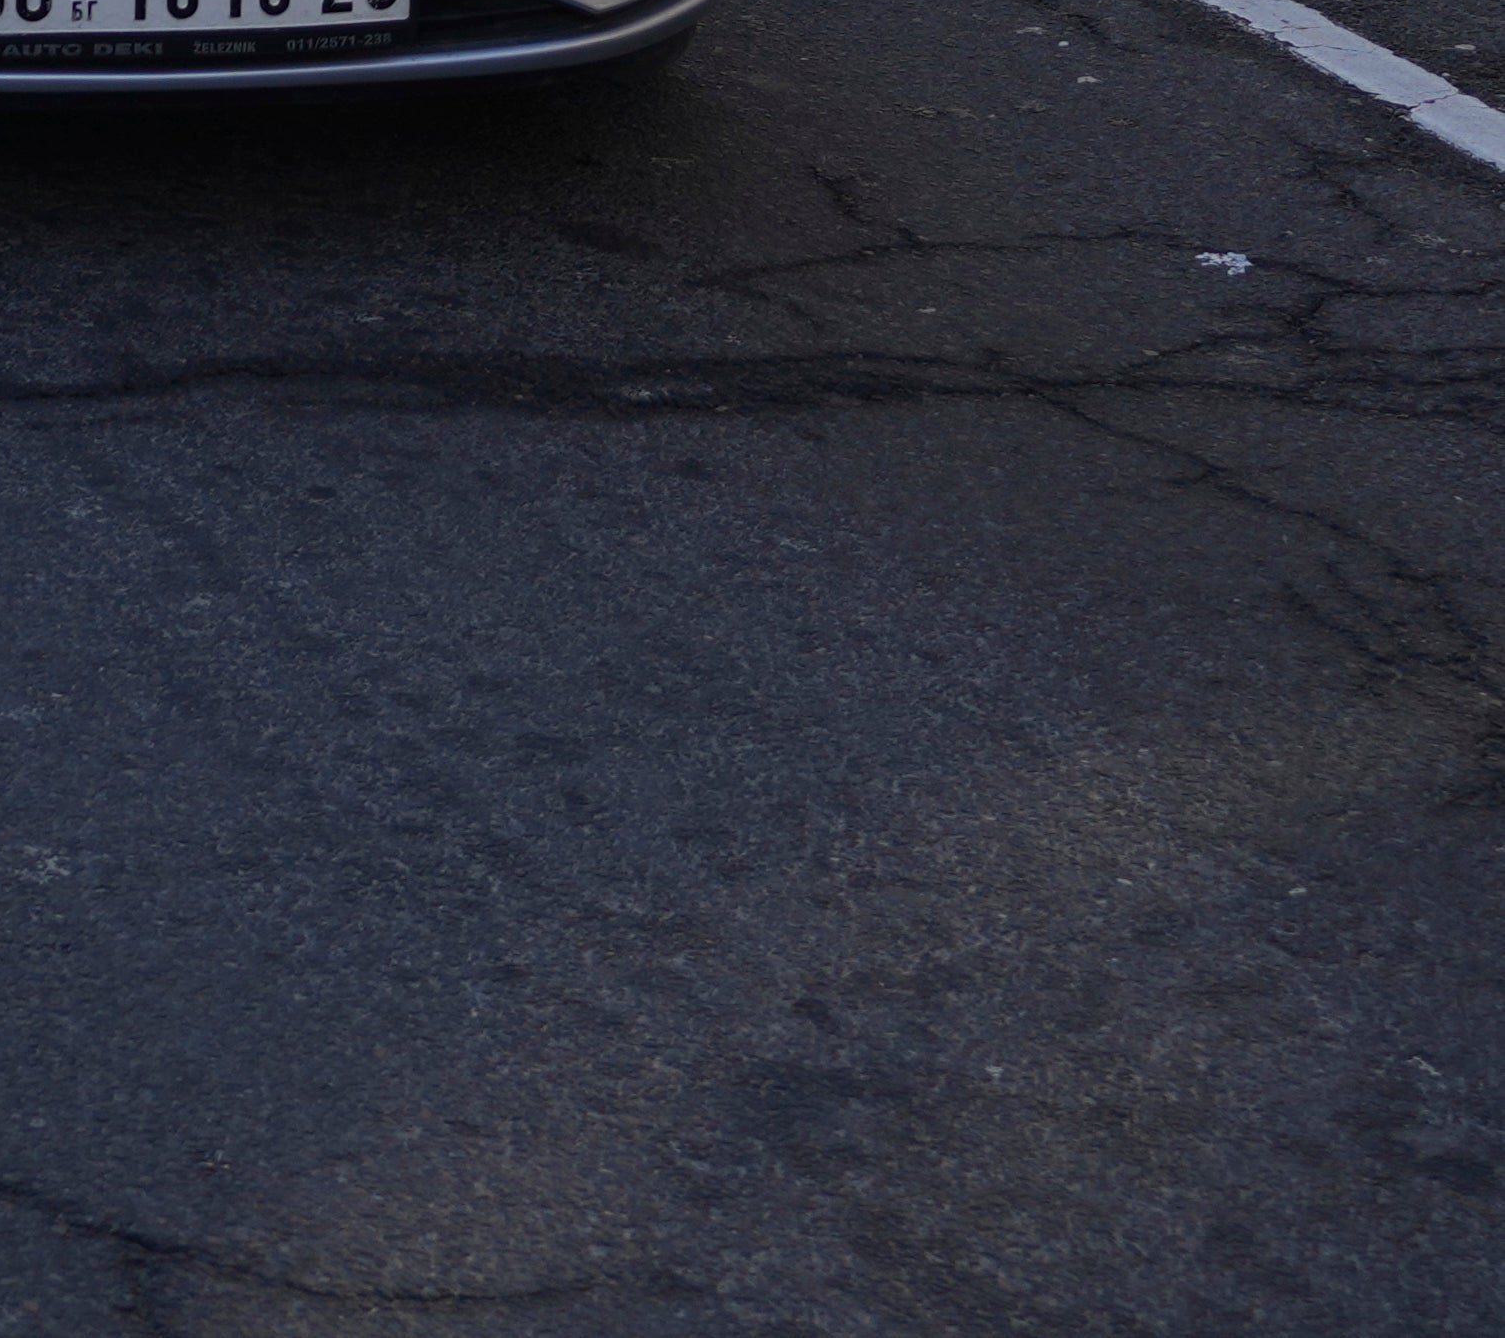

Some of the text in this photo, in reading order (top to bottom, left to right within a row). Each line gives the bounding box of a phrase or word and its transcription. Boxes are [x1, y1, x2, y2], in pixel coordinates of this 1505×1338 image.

[2, 42, 83, 58] AUTO
[93, 41, 163, 57] DEKI
[193, 38, 256, 55] ŽELEZNIK
